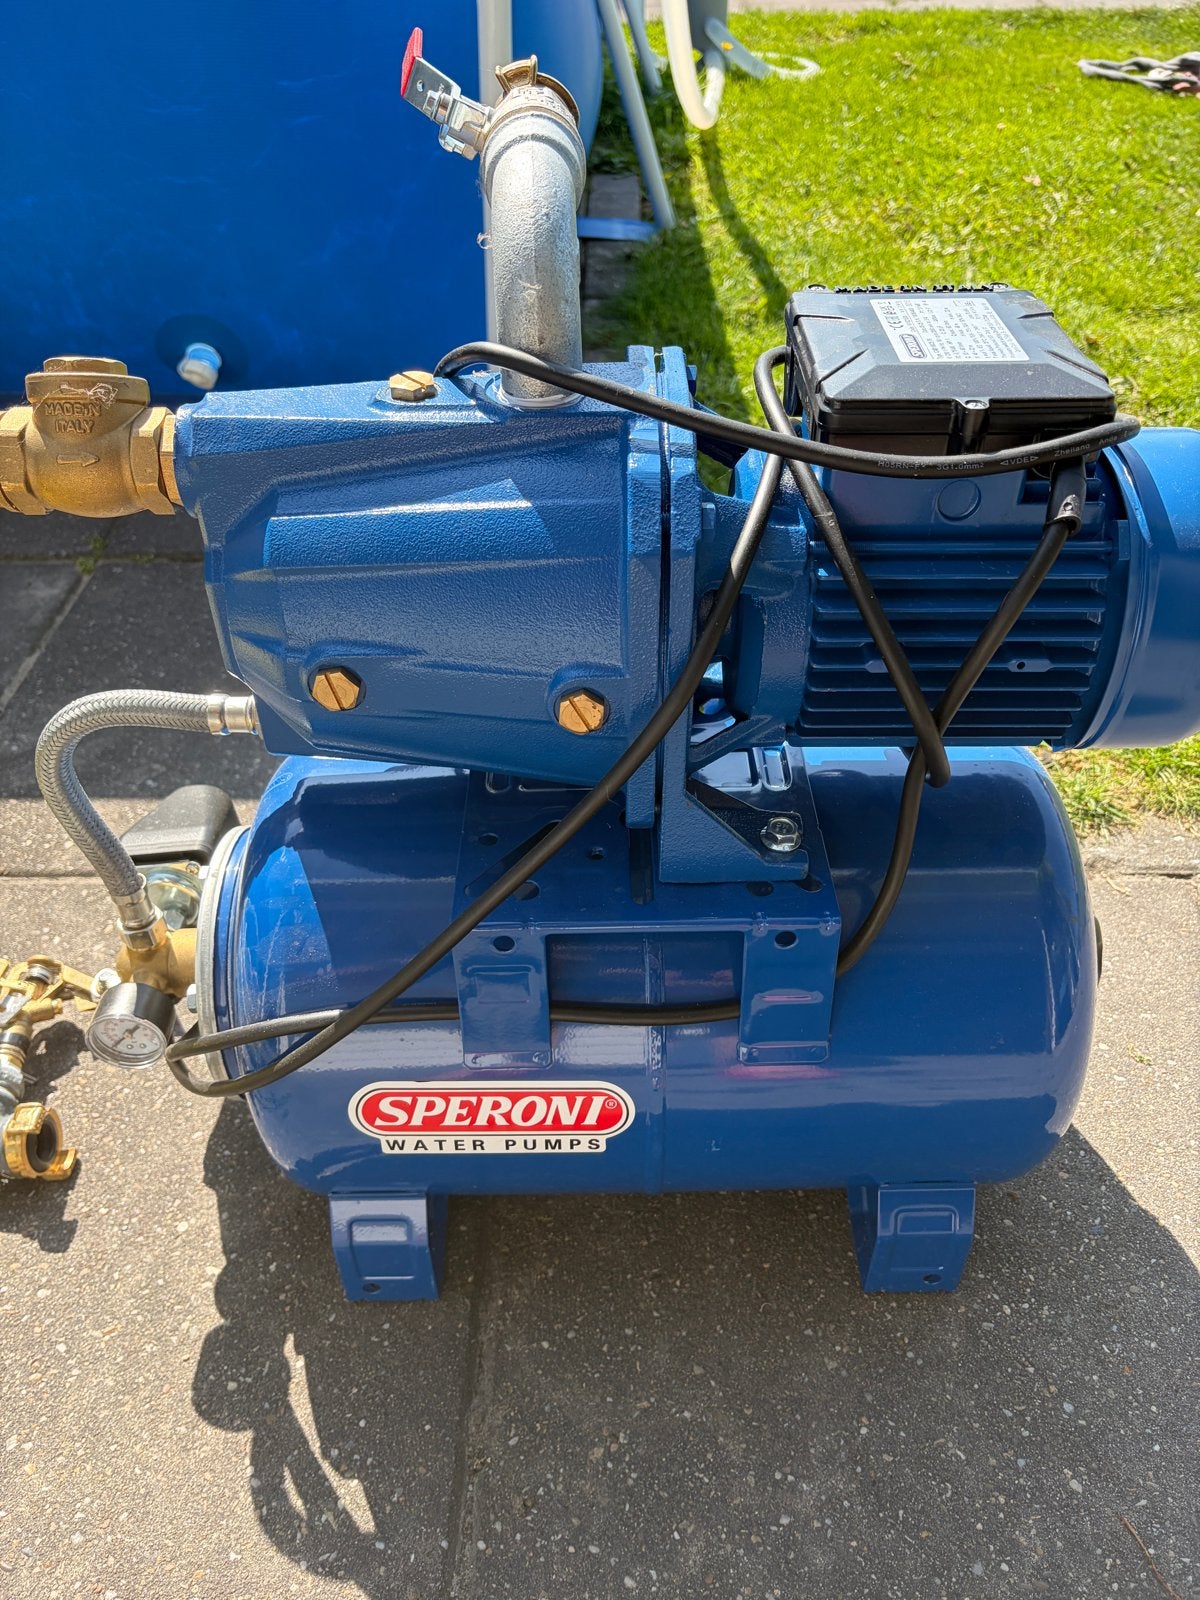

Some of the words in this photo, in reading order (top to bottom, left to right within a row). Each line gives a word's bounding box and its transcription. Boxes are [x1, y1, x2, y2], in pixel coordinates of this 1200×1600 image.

[835, 285, 895, 293] MADE
[45, 401, 84, 416] MADE
[55, 419, 95, 433] ITALY
[1010, 457, 1030, 465] VDE
[385, 1139, 486, 1151] WATER
[504, 1138, 601, 1151] PUMPS
